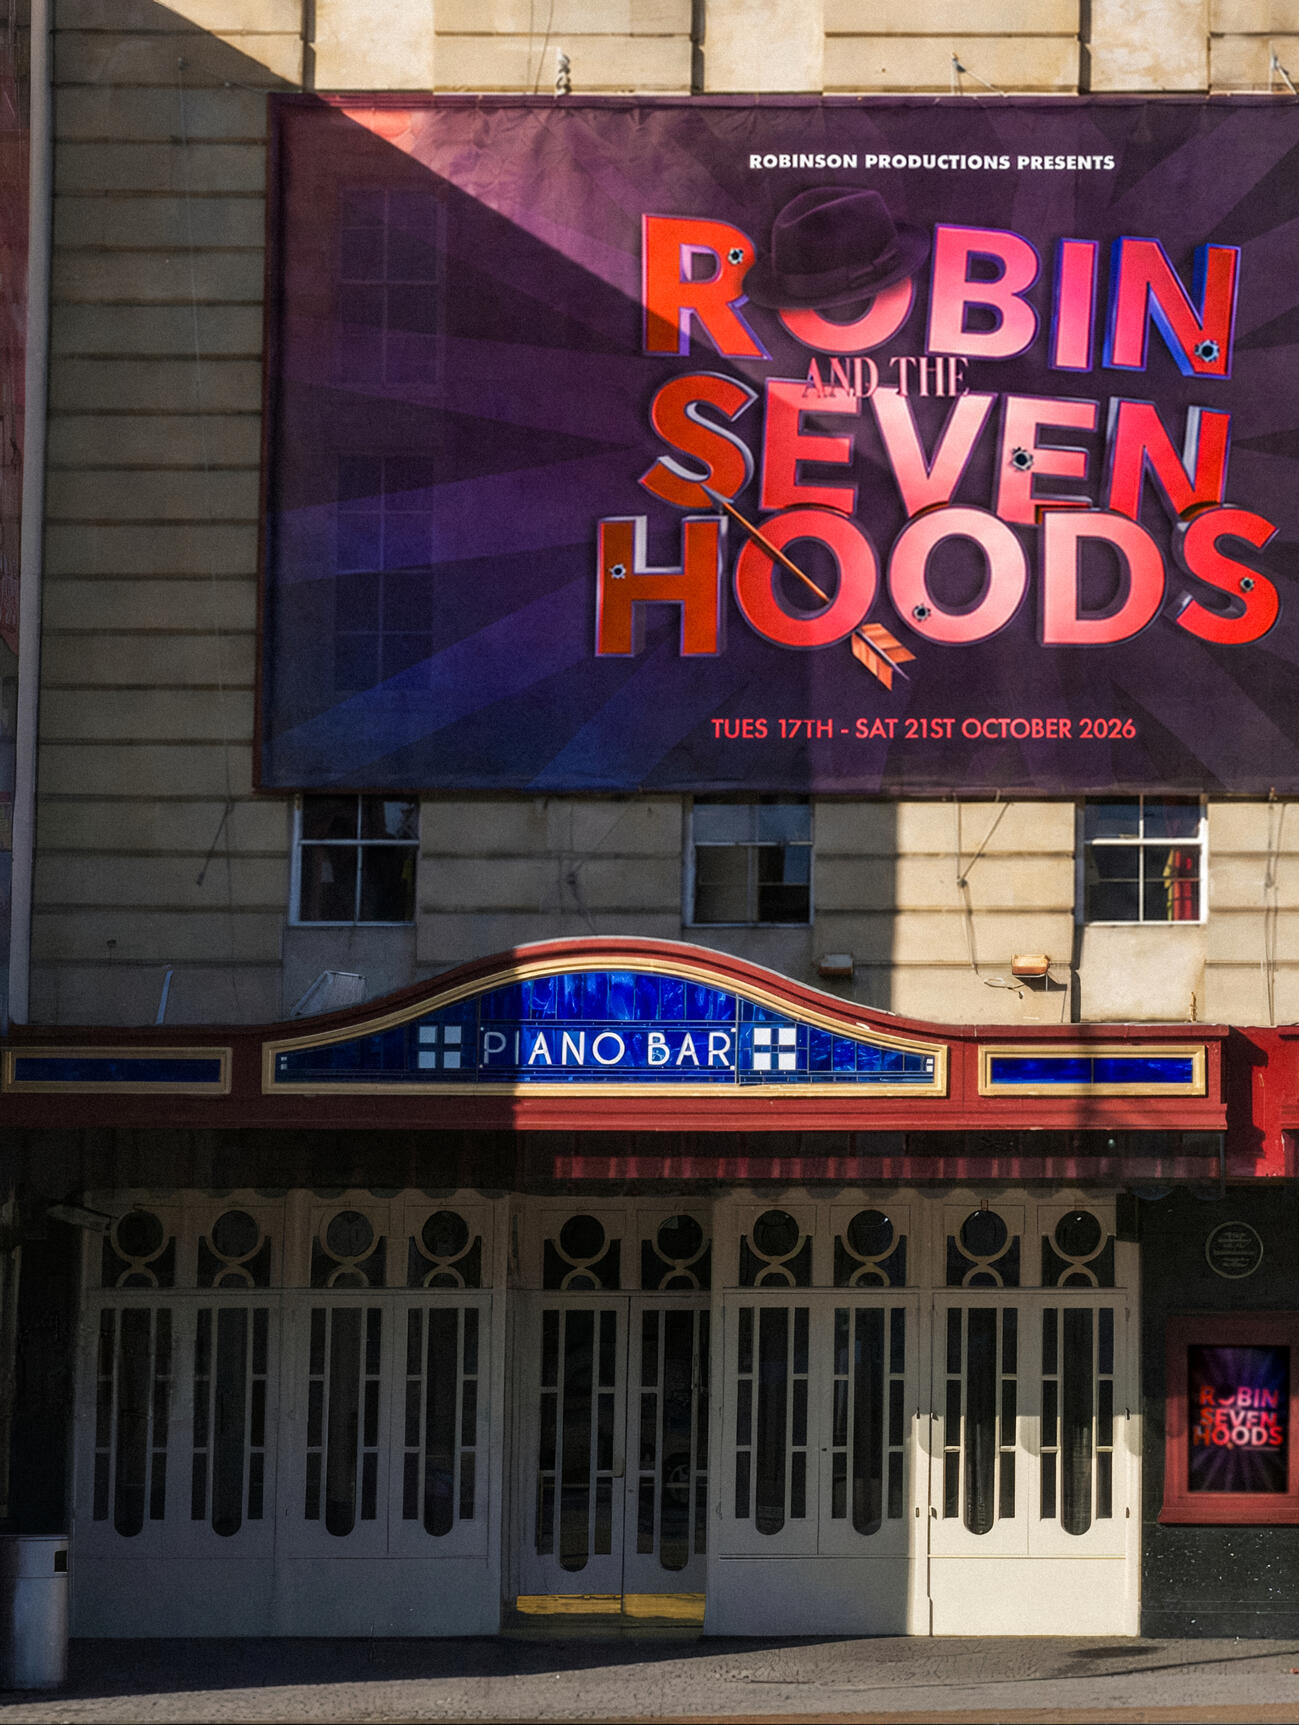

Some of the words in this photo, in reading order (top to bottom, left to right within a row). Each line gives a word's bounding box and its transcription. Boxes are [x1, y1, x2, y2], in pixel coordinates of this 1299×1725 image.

[749, 154, 857, 169] ROBINSON
[864, 154, 1011, 170] PRODUCTIONS
[1016, 155, 1116, 171] PRESENTS
[802, 357, 880, 400] AND
[888, 357, 970, 399] THE
[637, 371, 1234, 526] SEVEN
[594, 503, 1281, 658] HOODS
[711, 718, 768, 740] TUES
[778, 718, 833, 739] 17TH
[855, 718, 898, 739] SAT
[904, 718, 955, 739] 21ST
[961, 718, 1073, 740] OCTOBER
[1079, 718, 1137, 739] 2026
[483, 1030, 624, 1068] PIANO
[647, 1030, 732, 1068] BAR
